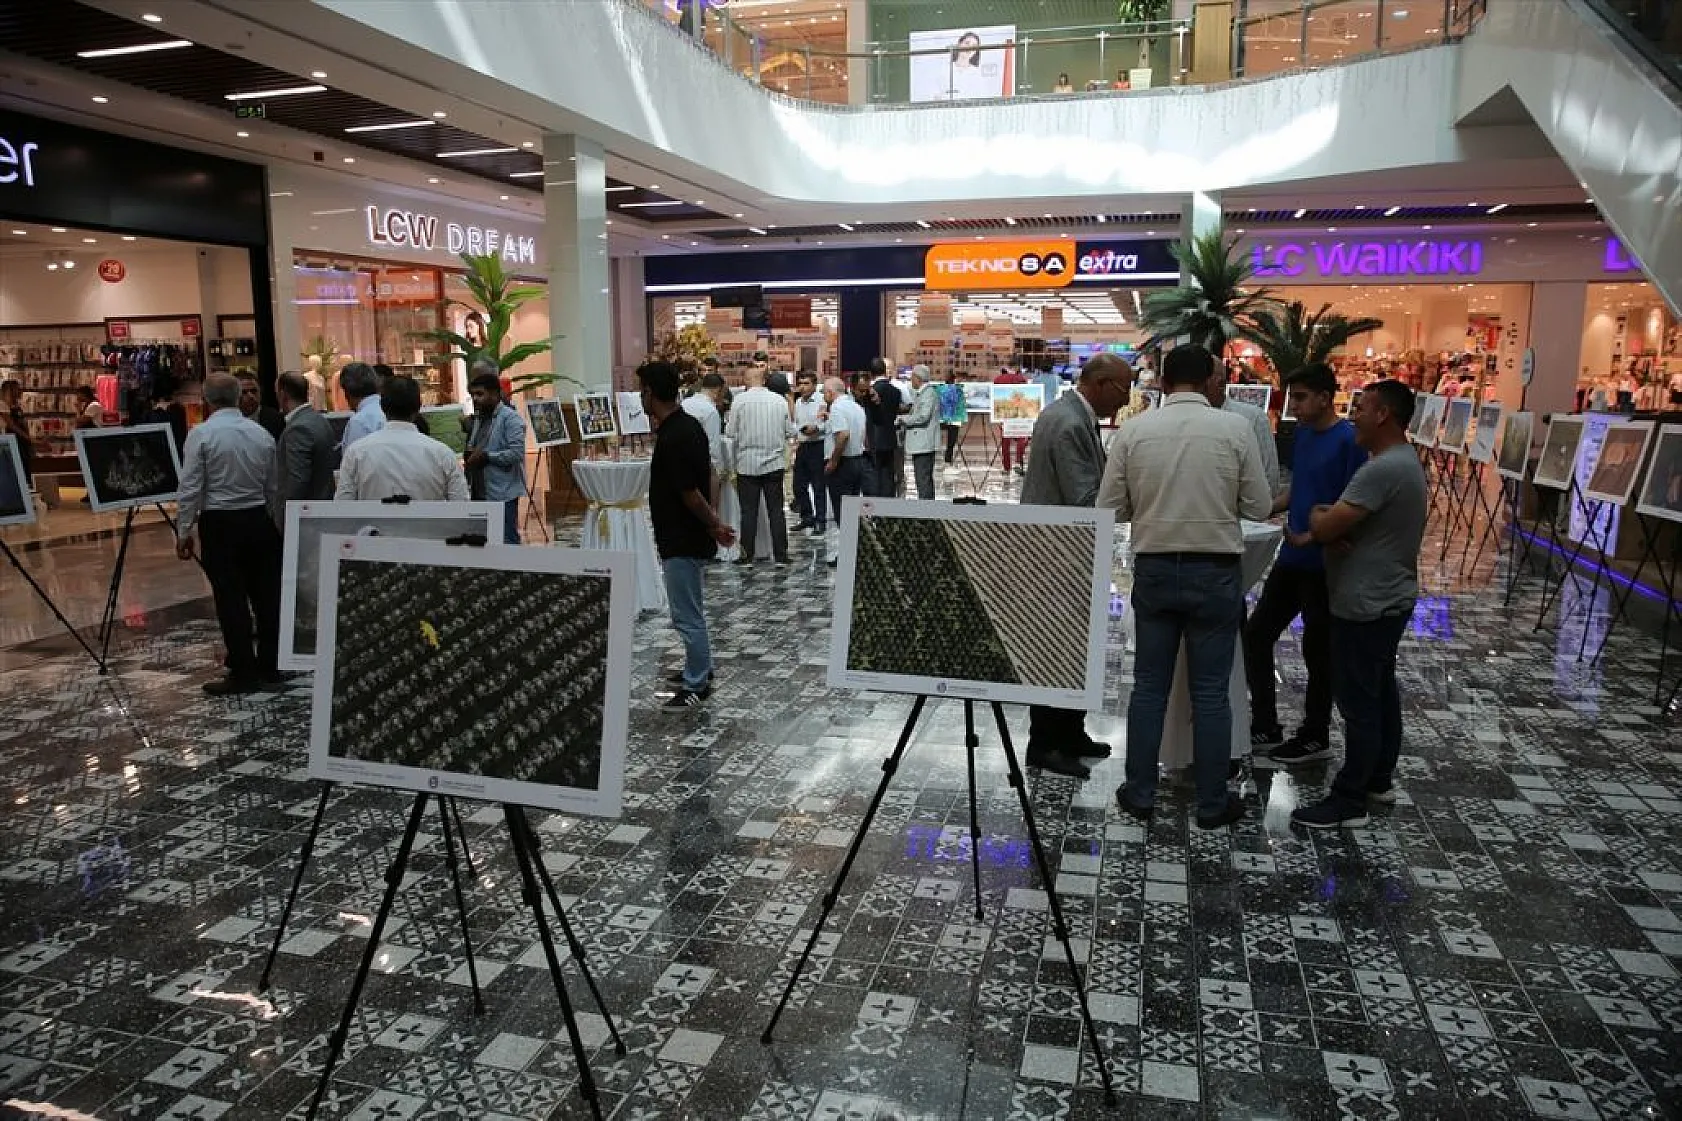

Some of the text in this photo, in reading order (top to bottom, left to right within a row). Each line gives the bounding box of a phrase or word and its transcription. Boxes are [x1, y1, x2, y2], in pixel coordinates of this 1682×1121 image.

[367, 205, 536, 264] LCW DREAM
[934, 249, 1139, 275] TEKNOSA extra
[1251, 242, 1306, 276] LC
[1604, 237, 1641, 270] L
